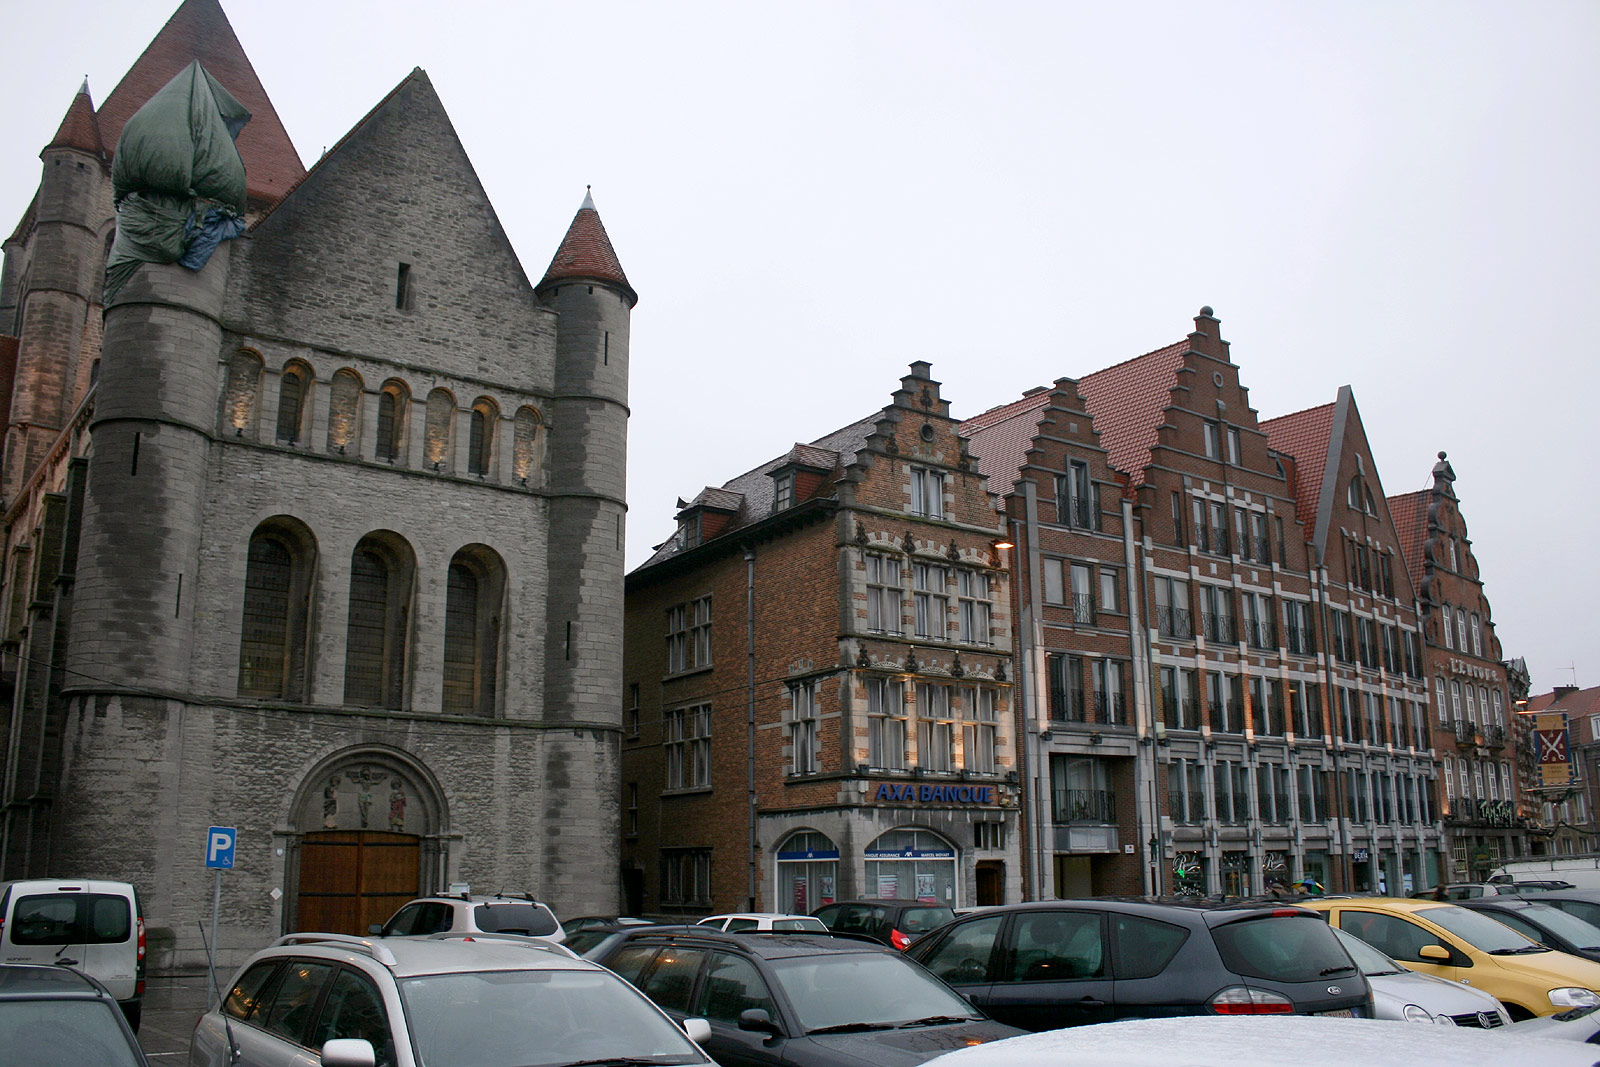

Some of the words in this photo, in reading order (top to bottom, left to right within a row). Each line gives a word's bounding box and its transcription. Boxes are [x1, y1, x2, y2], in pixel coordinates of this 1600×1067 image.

[876, 783, 916, 801] AXA
[920, 785, 993, 802] BANQUE
[209, 832, 232, 862] P
